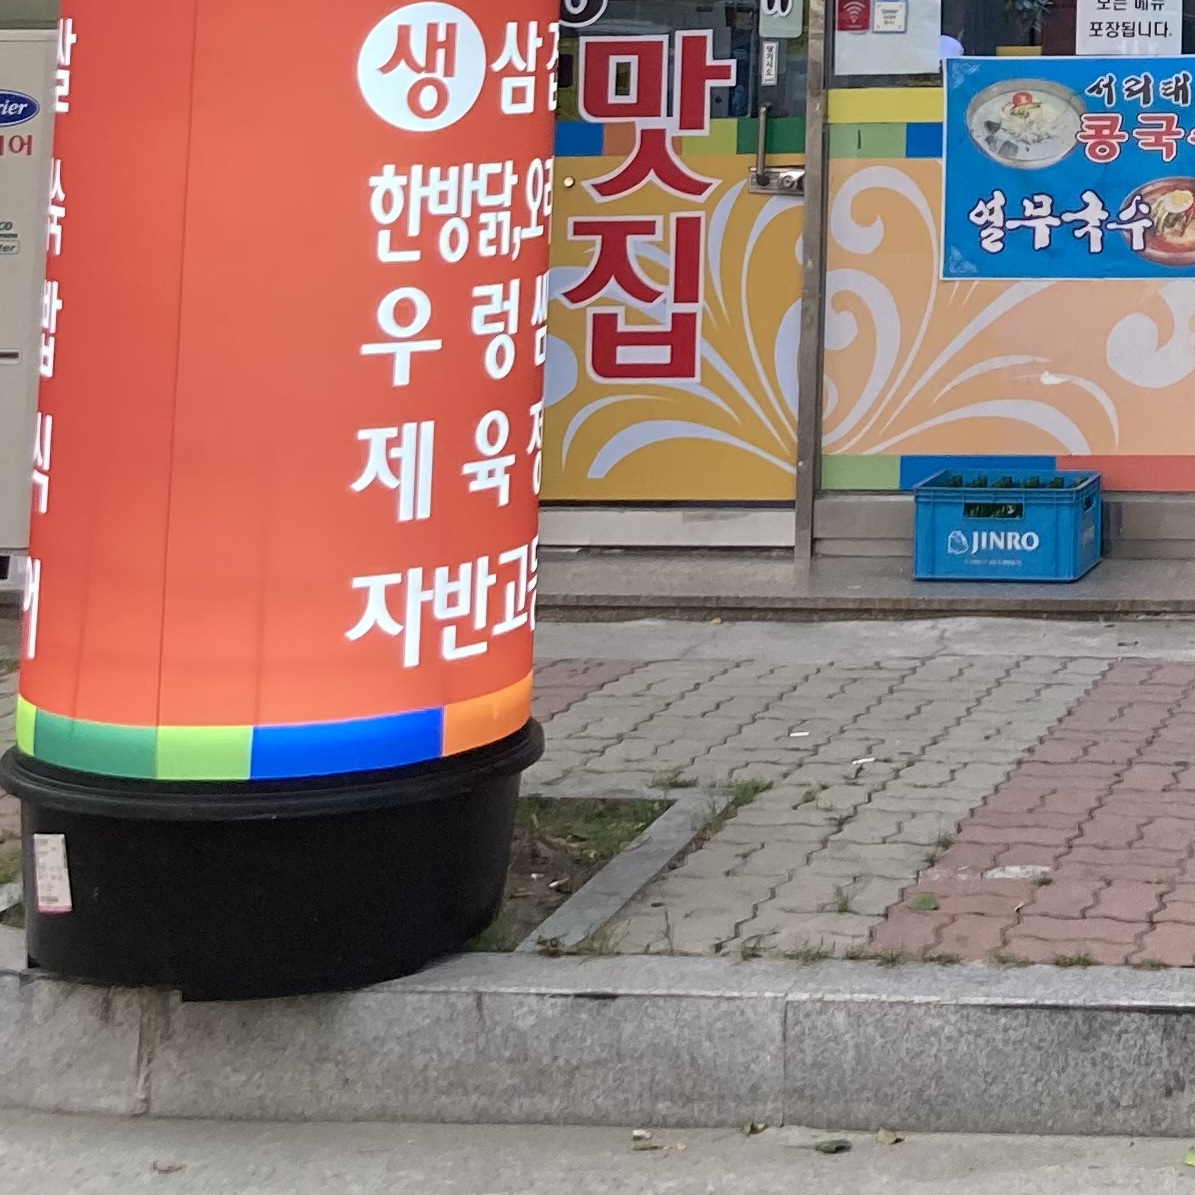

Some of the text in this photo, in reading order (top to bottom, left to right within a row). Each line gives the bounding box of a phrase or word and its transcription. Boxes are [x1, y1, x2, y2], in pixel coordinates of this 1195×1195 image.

[376, 19, 459, 120] 생
[1084, 71, 1195, 106] 서리태
[967, 189, 1155, 255] 열무국수
[970, 531, 1040, 555] JINRO
